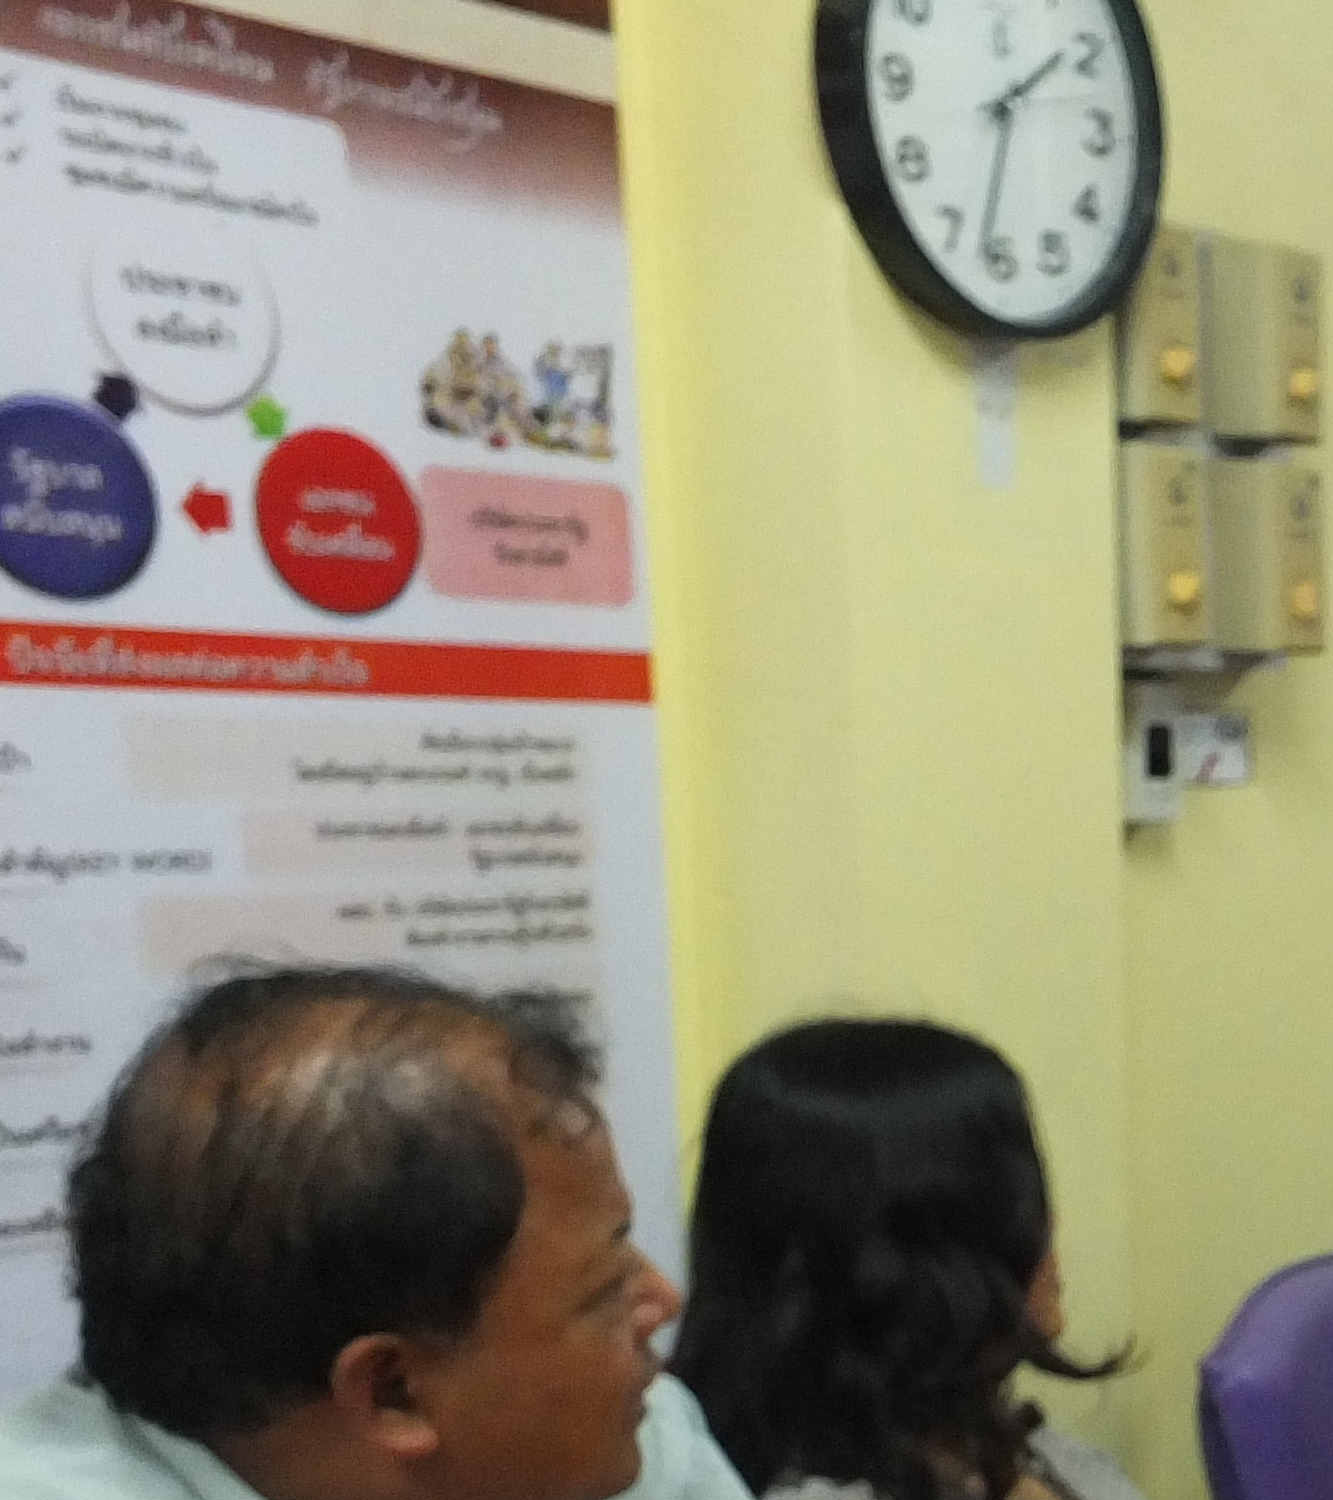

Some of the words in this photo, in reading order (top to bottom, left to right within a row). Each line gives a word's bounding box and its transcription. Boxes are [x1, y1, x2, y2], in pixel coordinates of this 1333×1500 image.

[1072, 31, 1102, 77] 2
[881, 52, 914, 103] 9
[1083, 108, 1115, 157] 3
[896, 135, 929, 182] 8
[937, 204, 964, 250] 7
[1072, 185, 1099, 224] 4
[984, 236, 1017, 282] 6
[1037, 228, 1070, 275] 5
